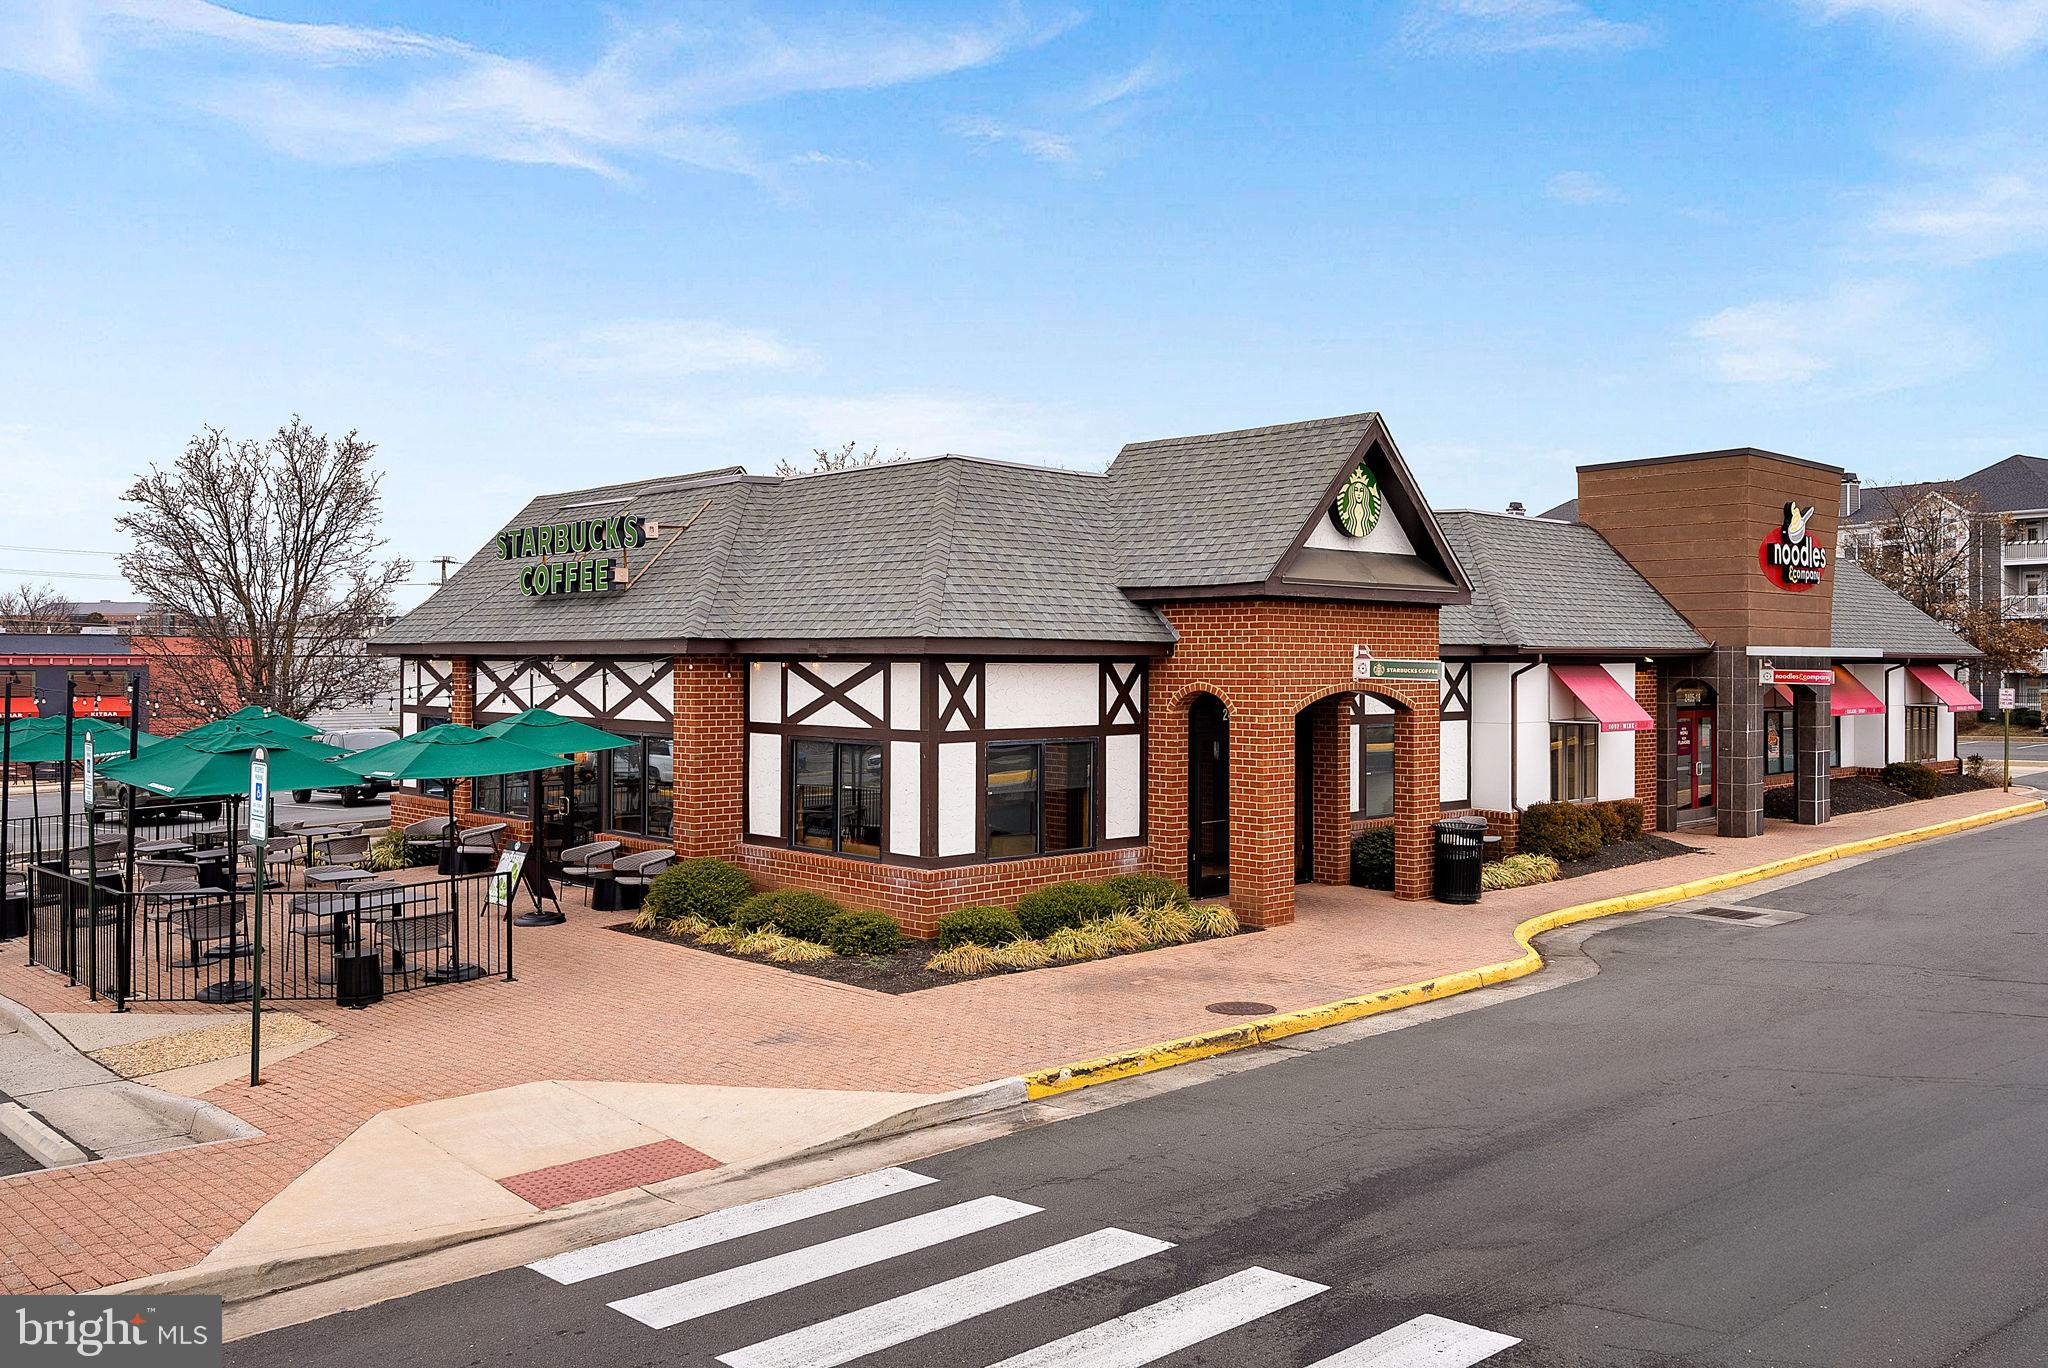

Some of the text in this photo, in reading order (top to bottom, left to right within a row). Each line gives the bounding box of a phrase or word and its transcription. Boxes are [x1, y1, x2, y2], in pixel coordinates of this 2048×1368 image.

[496, 514, 638, 560] STARBUCKS
[1774, 536, 1826, 568] noodles
[519, 559, 609, 596] COFFEE
